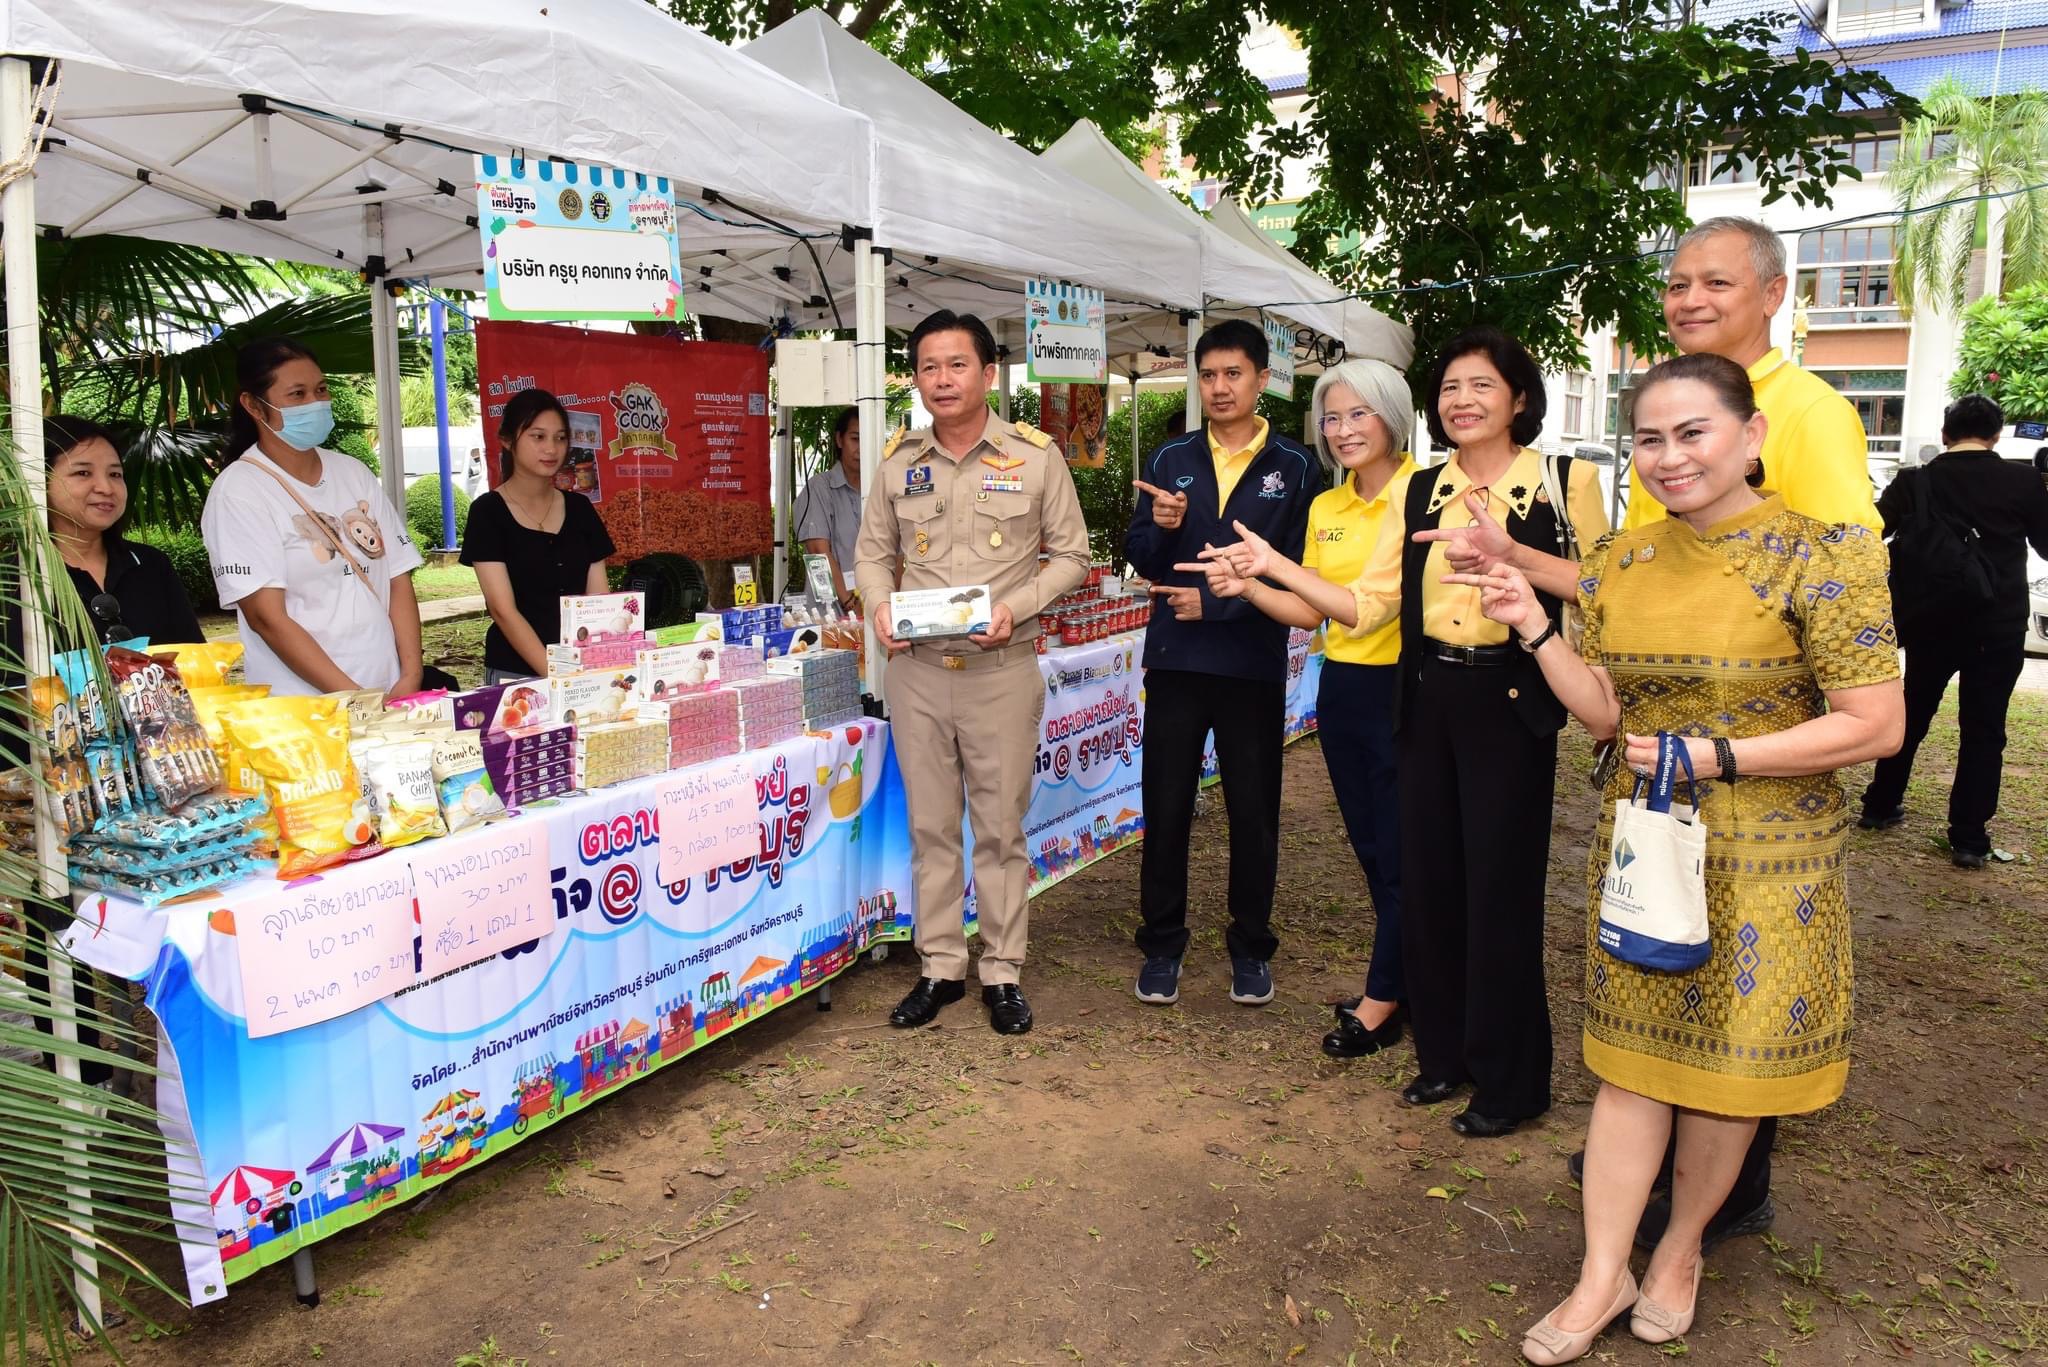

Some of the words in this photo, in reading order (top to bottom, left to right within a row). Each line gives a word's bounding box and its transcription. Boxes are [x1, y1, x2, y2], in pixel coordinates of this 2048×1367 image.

[502, 257, 545, 278] บริษัท
[582, 264, 632, 280] คอทเทจ
[636, 261, 669, 281] จำกัด
[1034, 333, 1101, 367] น้ำพริกกากคลุก
[619, 412, 662, 429] COOK
[626, 394, 654, 411] GAK
[1326, 532, 1343, 542] AC
[736, 583, 753, 604] 25
[129, 663, 165, 715] POP
[1045, 683, 1129, 744] ตลาดพาณิชย์
[1078, 702, 1142, 772] ราชบุรี
[688, 802, 710, 823] 45
[714, 798, 734, 814] บาท
[424, 837, 531, 889] ขนมอบกรอบ
[668, 846, 683, 866] 3
[688, 832, 717, 856] กล่อง
[725, 824, 746, 844] 100
[461, 887, 490, 908] 30
[498, 872, 528, 894] บาท
[308, 936, 336, 959] 60
[341, 924, 374, 946] บาท
[466, 924, 480, 946] 1
[525, 904, 535, 922] 1
[644, 960, 678, 988] ร่วมกับ
[677, 930, 748, 975] ภาครัฐและเอกชน
[749, 904, 804, 942] จังหวัดราชบุรี
[266, 996, 288, 1018] 2
[353, 965, 382, 988] 100
